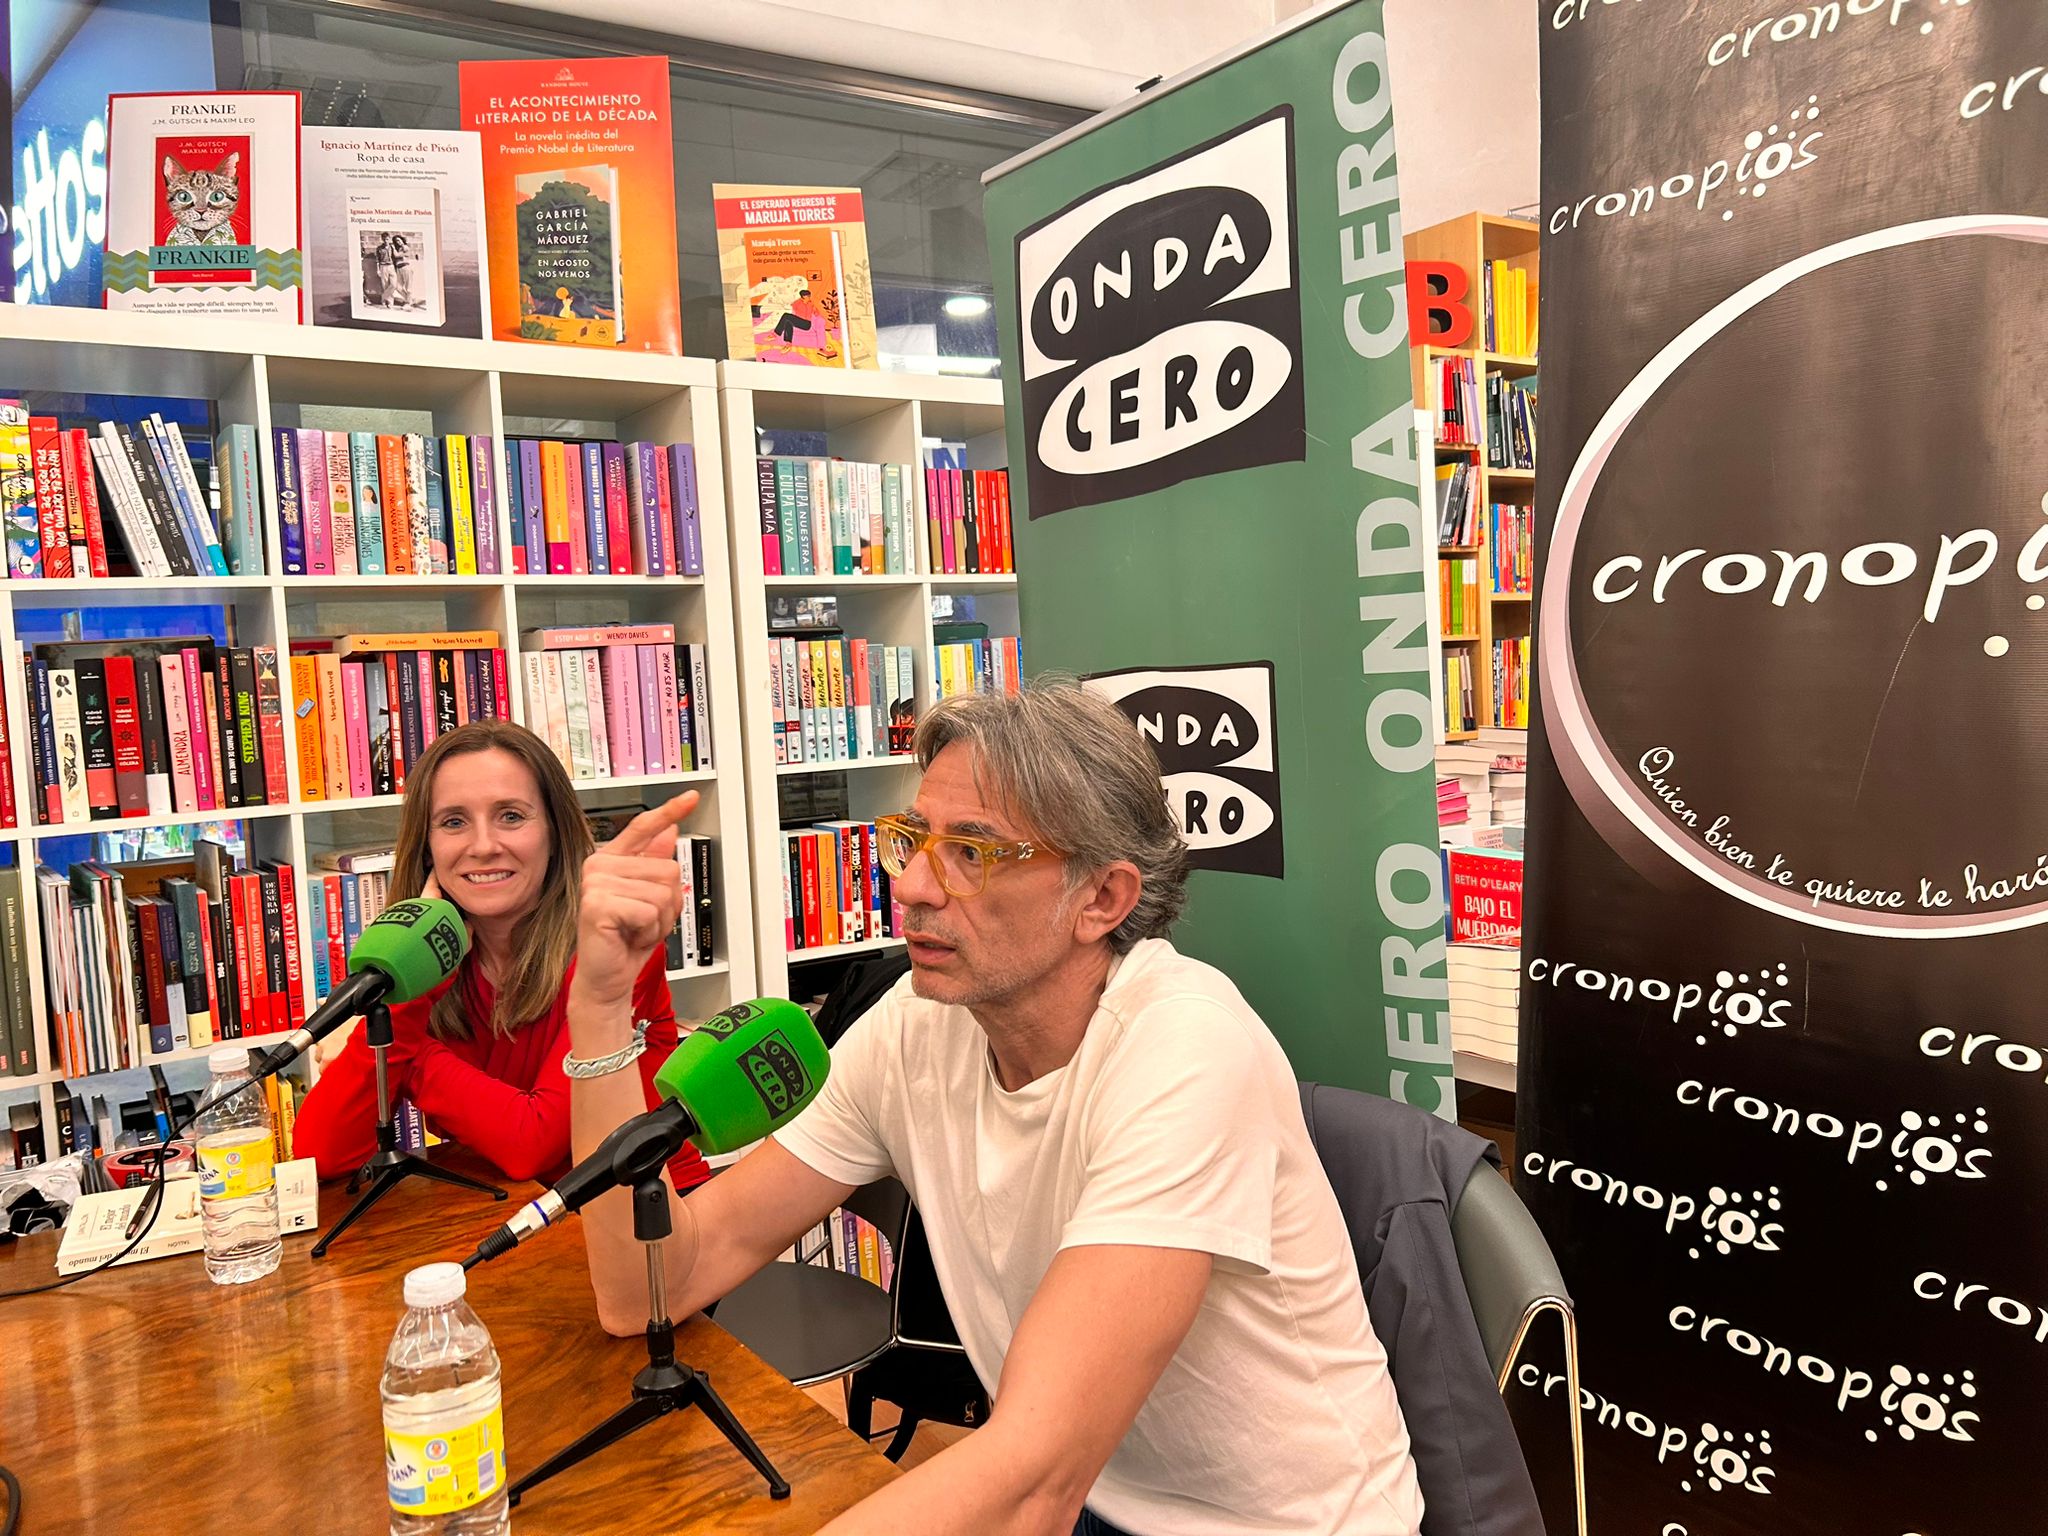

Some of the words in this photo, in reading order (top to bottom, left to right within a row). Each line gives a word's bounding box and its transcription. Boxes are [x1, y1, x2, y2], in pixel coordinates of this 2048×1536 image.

[171, 104, 236, 115] FRANKIE
[490, 98, 504, 108] EL
[509, 94, 641, 108] ACONTECIMIENTO
[475, 111, 546, 125] LITERARIO
[552, 111, 569, 122] DE
[575, 111, 593, 122] LA
[598, 107, 658, 121] DÉCADA
[321, 140, 360, 150] Ignacio
[364, 140, 412, 151] Martínez
[416, 143, 428, 152] de
[431, 143, 460, 153] Pisón
[514, 131, 526, 142] La
[530, 132, 562, 141] novela
[566, 130, 600, 140] inédita
[603, 128, 619, 140] del
[357, 153, 385, 164] Ropa
[388, 154, 400, 163] de
[403, 155, 425, 163] casa
[500, 144, 534, 154] Premio
[537, 143, 568, 153] Nobel
[571, 144, 584, 153] de
[587, 143, 635, 153] Literatura
[1332, 26, 1409, 359] CERO
[1549, 130, 1824, 235] cronopios
[536, 208, 588, 220] GABRIEL
[740, 201, 749, 210] EL
[751, 199, 790, 210] ESPERADO
[791, 197, 825, 208] REGRESO
[826, 197, 836, 206] DE
[350, 217, 367, 225] Ropa
[536, 220, 588, 232] GARCÍA
[745, 210, 790, 225] MARUJA
[793, 208, 835, 222] TORRES
[537, 234, 589, 245] MÁRQUEZ
[157, 249, 249, 265] FRANKIE
[538, 259, 549, 267] EN
[552, 259, 590, 267] AGOSTO
[559, 271, 591, 279] VEMOS
[1050, 213, 1246, 334] ONDA
[1405, 261, 1473, 348] B
[1066, 346, 1254, 452] CERO
[608, 459, 616, 488] LAUREN
[614, 456, 622, 492] CHRISTINA
[760, 472, 775, 504] CULPA
[779, 475, 794, 507] CULPA
[795, 475, 808, 507] CULPA
[310, 501, 322, 535] ESNOB
[370, 516, 381, 545] FUIMOS
[764, 508, 776, 533] MÍA
[784, 510, 794, 543] TUYA
[360, 516, 372, 559] CANCIONES
[800, 511, 809, 564] NUESTRA
[1351, 400, 1436, 773] ONDA
[606, 632, 627, 641] WENDY
[628, 631, 649, 639] DAVIES
[530, 656, 540, 685] GAMES
[548, 656, 556, 675] HATE
[569, 656, 578, 673] LIES
[587, 657, 596, 673] IRA
[237, 690, 249, 715] KING
[240, 718, 254, 764] STEPHEN
[1137, 712, 1240, 747] NDA
[174, 730, 191, 776] ALMENDRA
[1185, 790, 1245, 835] RO
[868, 832, 876, 848] GIRL
[1638, 747, 1697, 828] Quien
[1704, 816, 1754, 869] bien
[1764, 853, 1794, 886] te
[1805, 878, 1904, 908] quiere
[1918, 877, 1951, 908] te
[841, 833, 849, 848] GIRL
[851, 833, 859, 849] GIRL
[852, 849, 860, 866] GEEK
[869, 848, 877, 864] GEEK
[347, 880, 355, 901] HOOVER
[1455, 873, 1478, 886] BETH
[6, 897, 13, 905] El
[348, 901, 356, 923] COLLEEN
[807, 887, 815, 915] Magnolia
[1464, 895, 1495, 918] BAJO
[1500, 900, 1515, 919] EL
[284, 902, 296, 936] LUCAS
[252, 923, 263, 976] BORDADORA
[287, 936, 300, 981] GEORGE
[435, 936, 451, 967] CERO
[1375, 842, 1457, 1124] CERO
[1528, 957, 1791, 1028] cronopios
[771, 1045, 800, 1091] ONDA
[753, 1060, 786, 1106] CERO
[410, 1128, 420, 1149] CAER
[1676, 1080, 1992, 1179] cronopios
[1523, 1152, 1784, 1252] cronopios
[848, 1240, 857, 1264] AFTER
[864, 1236, 873, 1259] AFTER
[68, 1256, 98, 1267] mundo
[1669, 1304, 1980, 1441] cronopios
